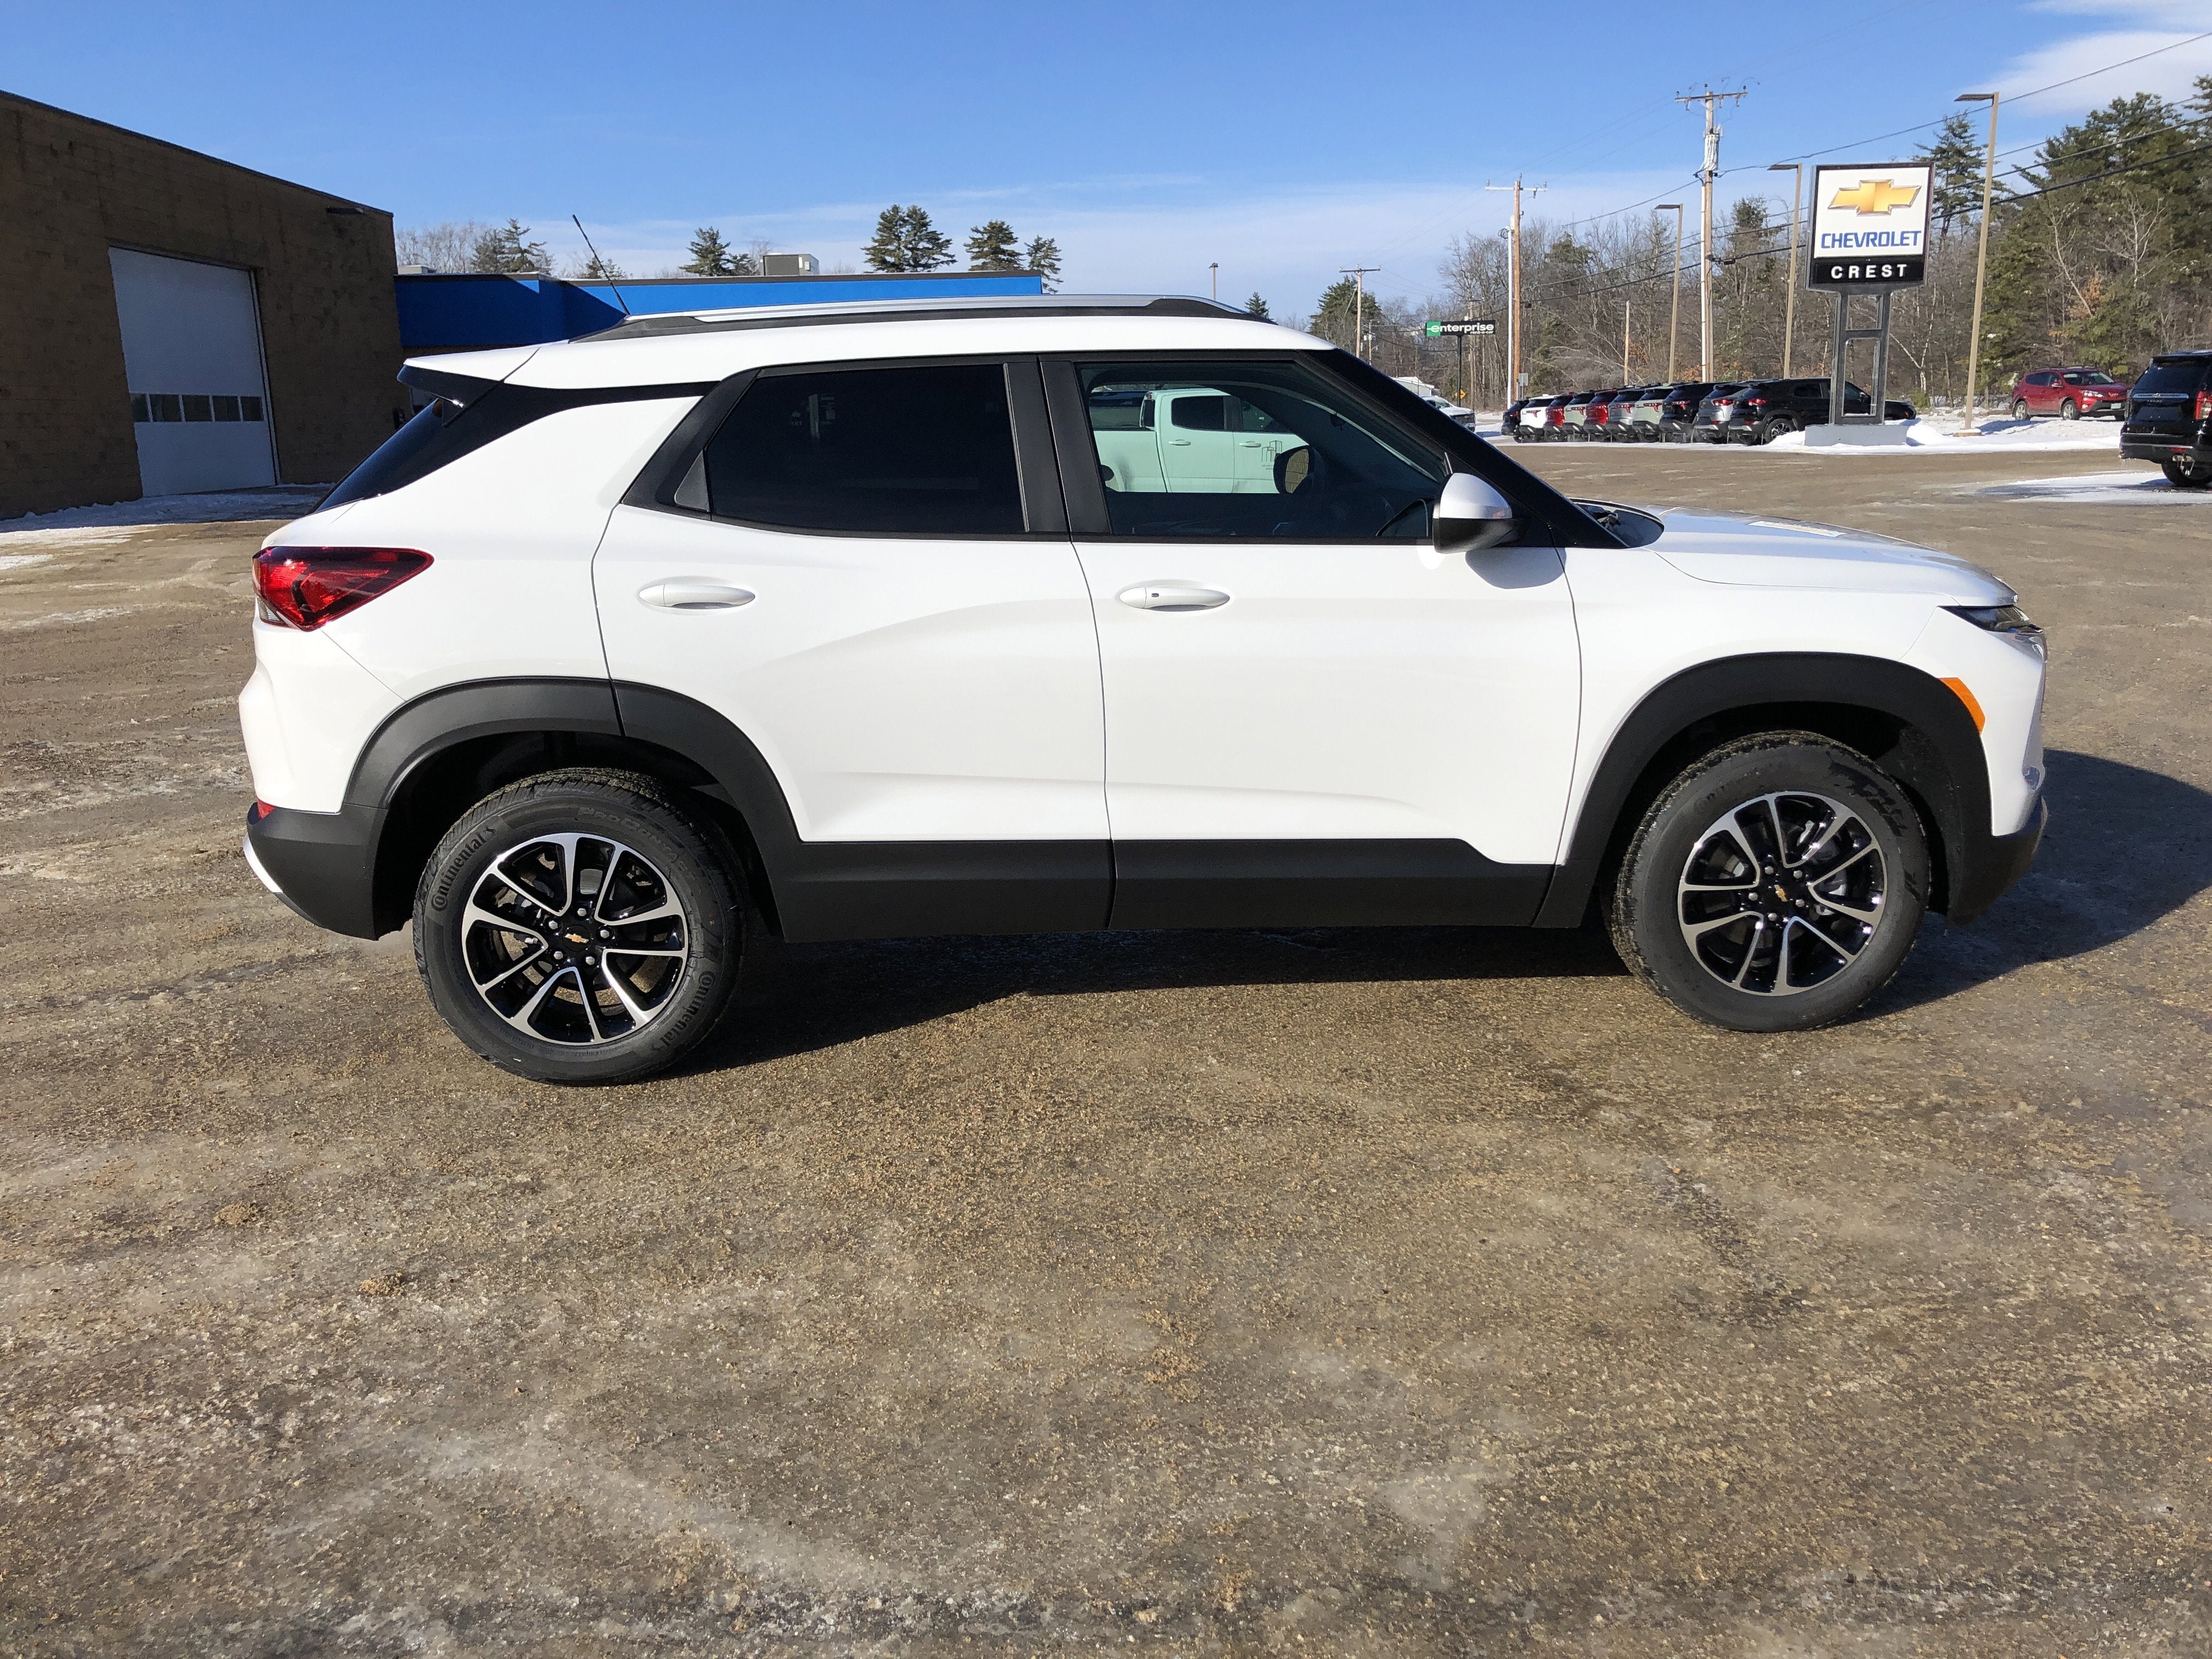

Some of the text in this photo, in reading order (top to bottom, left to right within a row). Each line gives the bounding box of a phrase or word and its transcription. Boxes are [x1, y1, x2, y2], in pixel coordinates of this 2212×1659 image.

[1821, 231, 1922, 249] CHEVROLET
[1831, 264, 1907, 279] CREST
[1429, 323, 1494, 334] enterprise
[431, 832, 487, 911] Continental
[659, 970, 715, 1046] Continental
